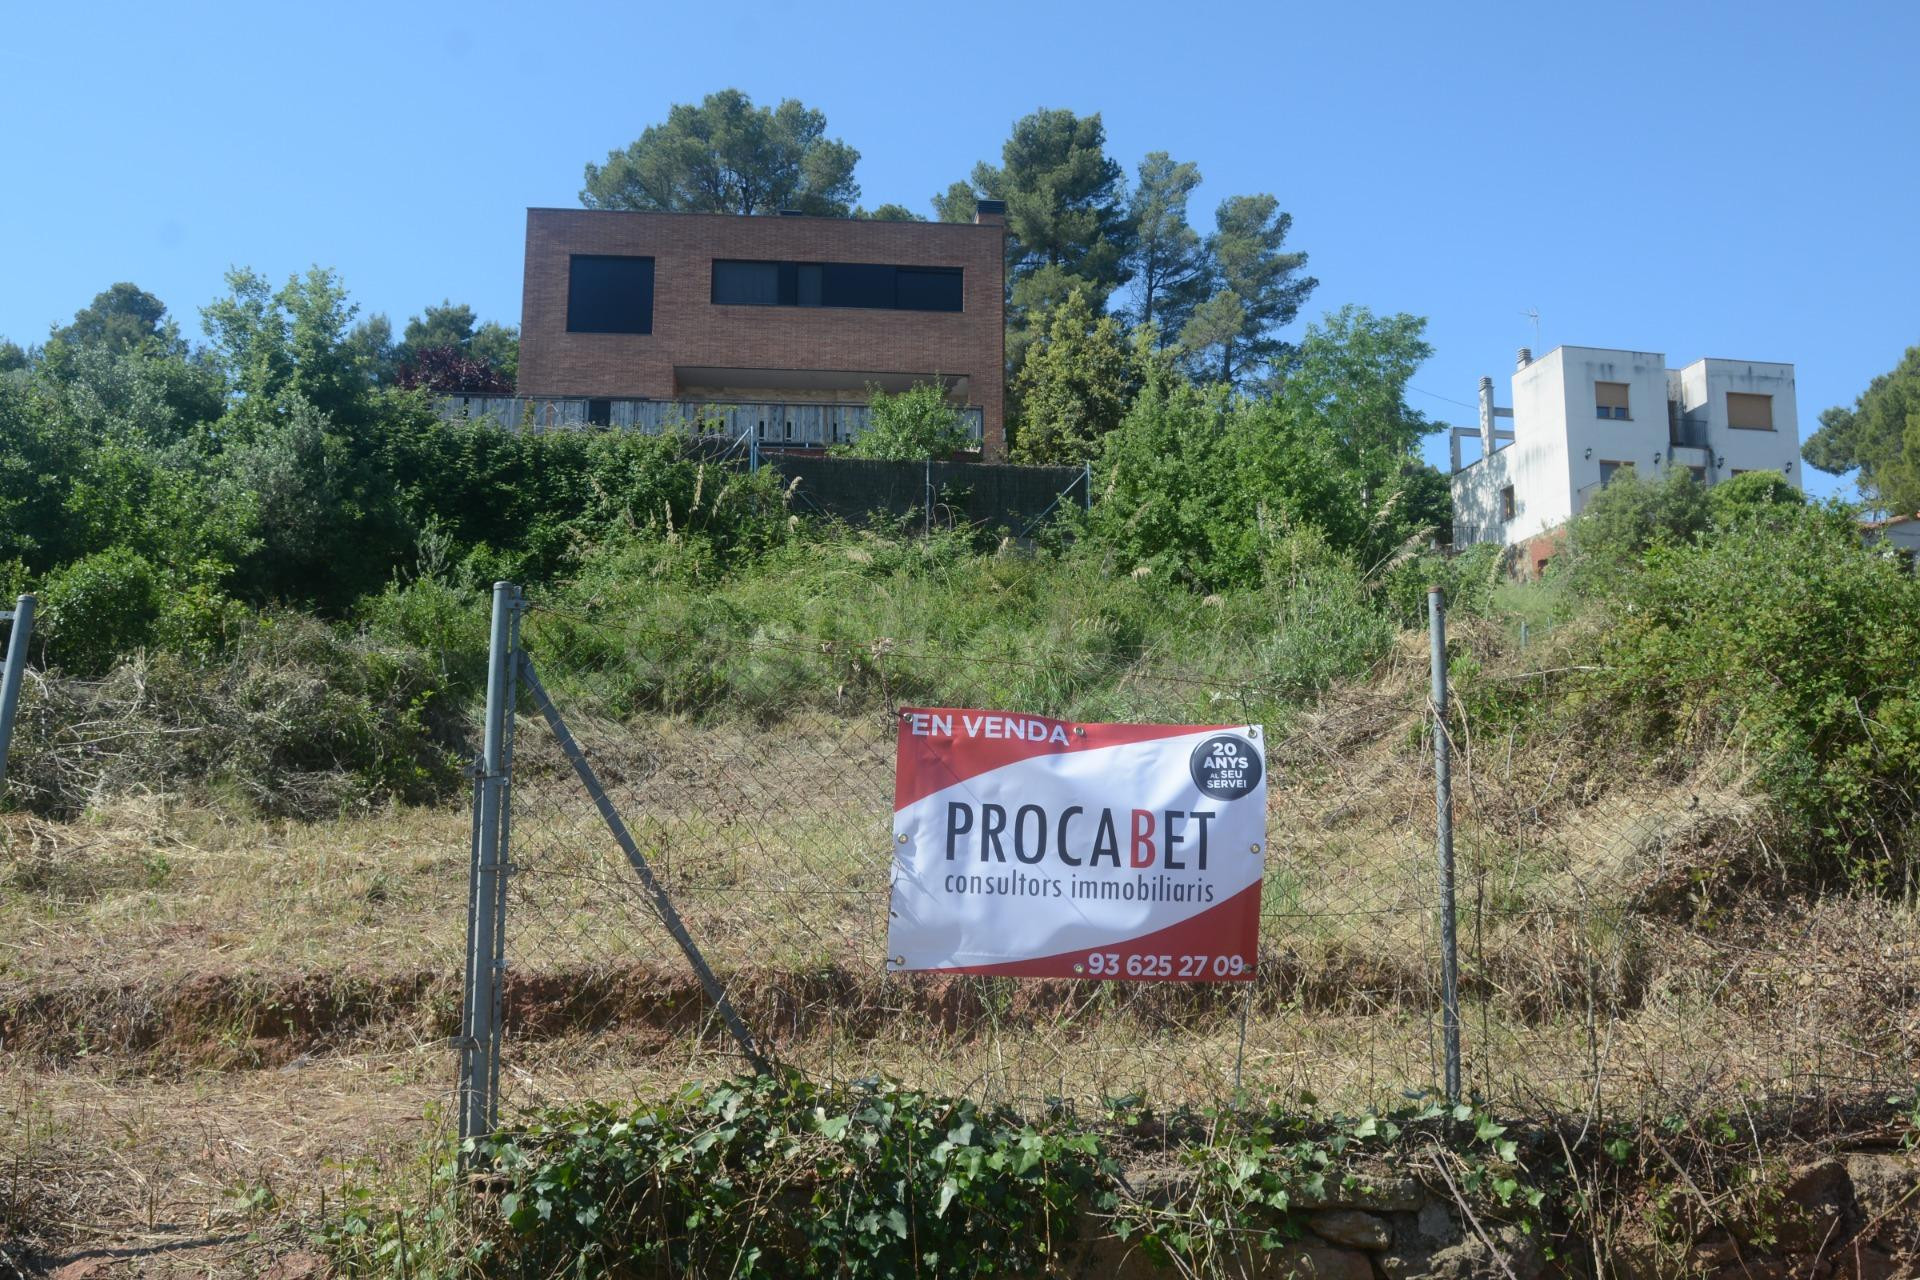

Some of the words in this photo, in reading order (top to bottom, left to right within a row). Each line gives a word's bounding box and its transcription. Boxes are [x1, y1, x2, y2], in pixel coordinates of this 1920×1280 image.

[912, 714, 952, 736] EN
[963, 715, 1069, 746] VENDA
[1212, 743, 1237, 756] 20
[1203, 757, 1249, 769] ANYS
[1221, 770, 1243, 778] SEU
[1207, 780, 1247, 788] SERVEI
[946, 802, 1216, 870] PROCABET
[945, 869, 1062, 897] consultors
[1071, 874, 1214, 902] immobiliaris
[1088, 953, 1120, 976] 93
[1126, 954, 1172, 976] 625
[1178, 955, 1208, 977] 27
[1213, 955, 1244, 977] 09
